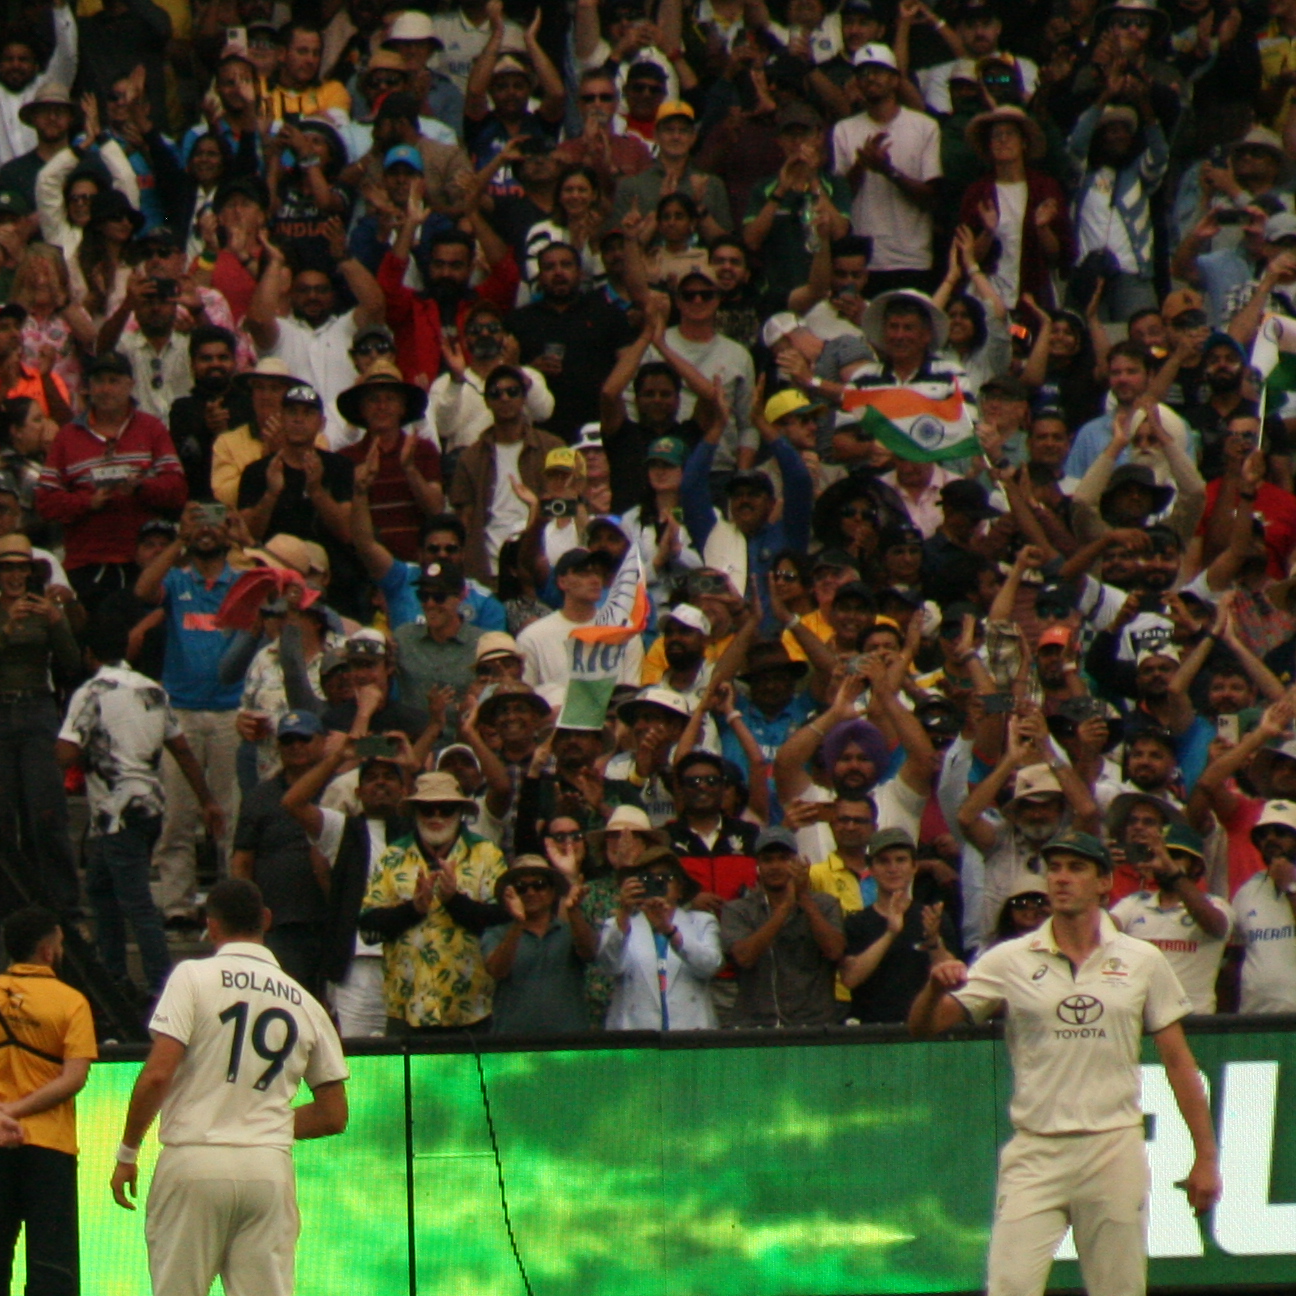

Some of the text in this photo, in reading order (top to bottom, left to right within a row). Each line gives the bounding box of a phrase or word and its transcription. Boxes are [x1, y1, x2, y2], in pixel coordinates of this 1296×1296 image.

[221, 970, 302, 1006] BOLAND
[219, 1001, 299, 1092] 19
[1055, 1028, 1106, 1041] TOYOTA
